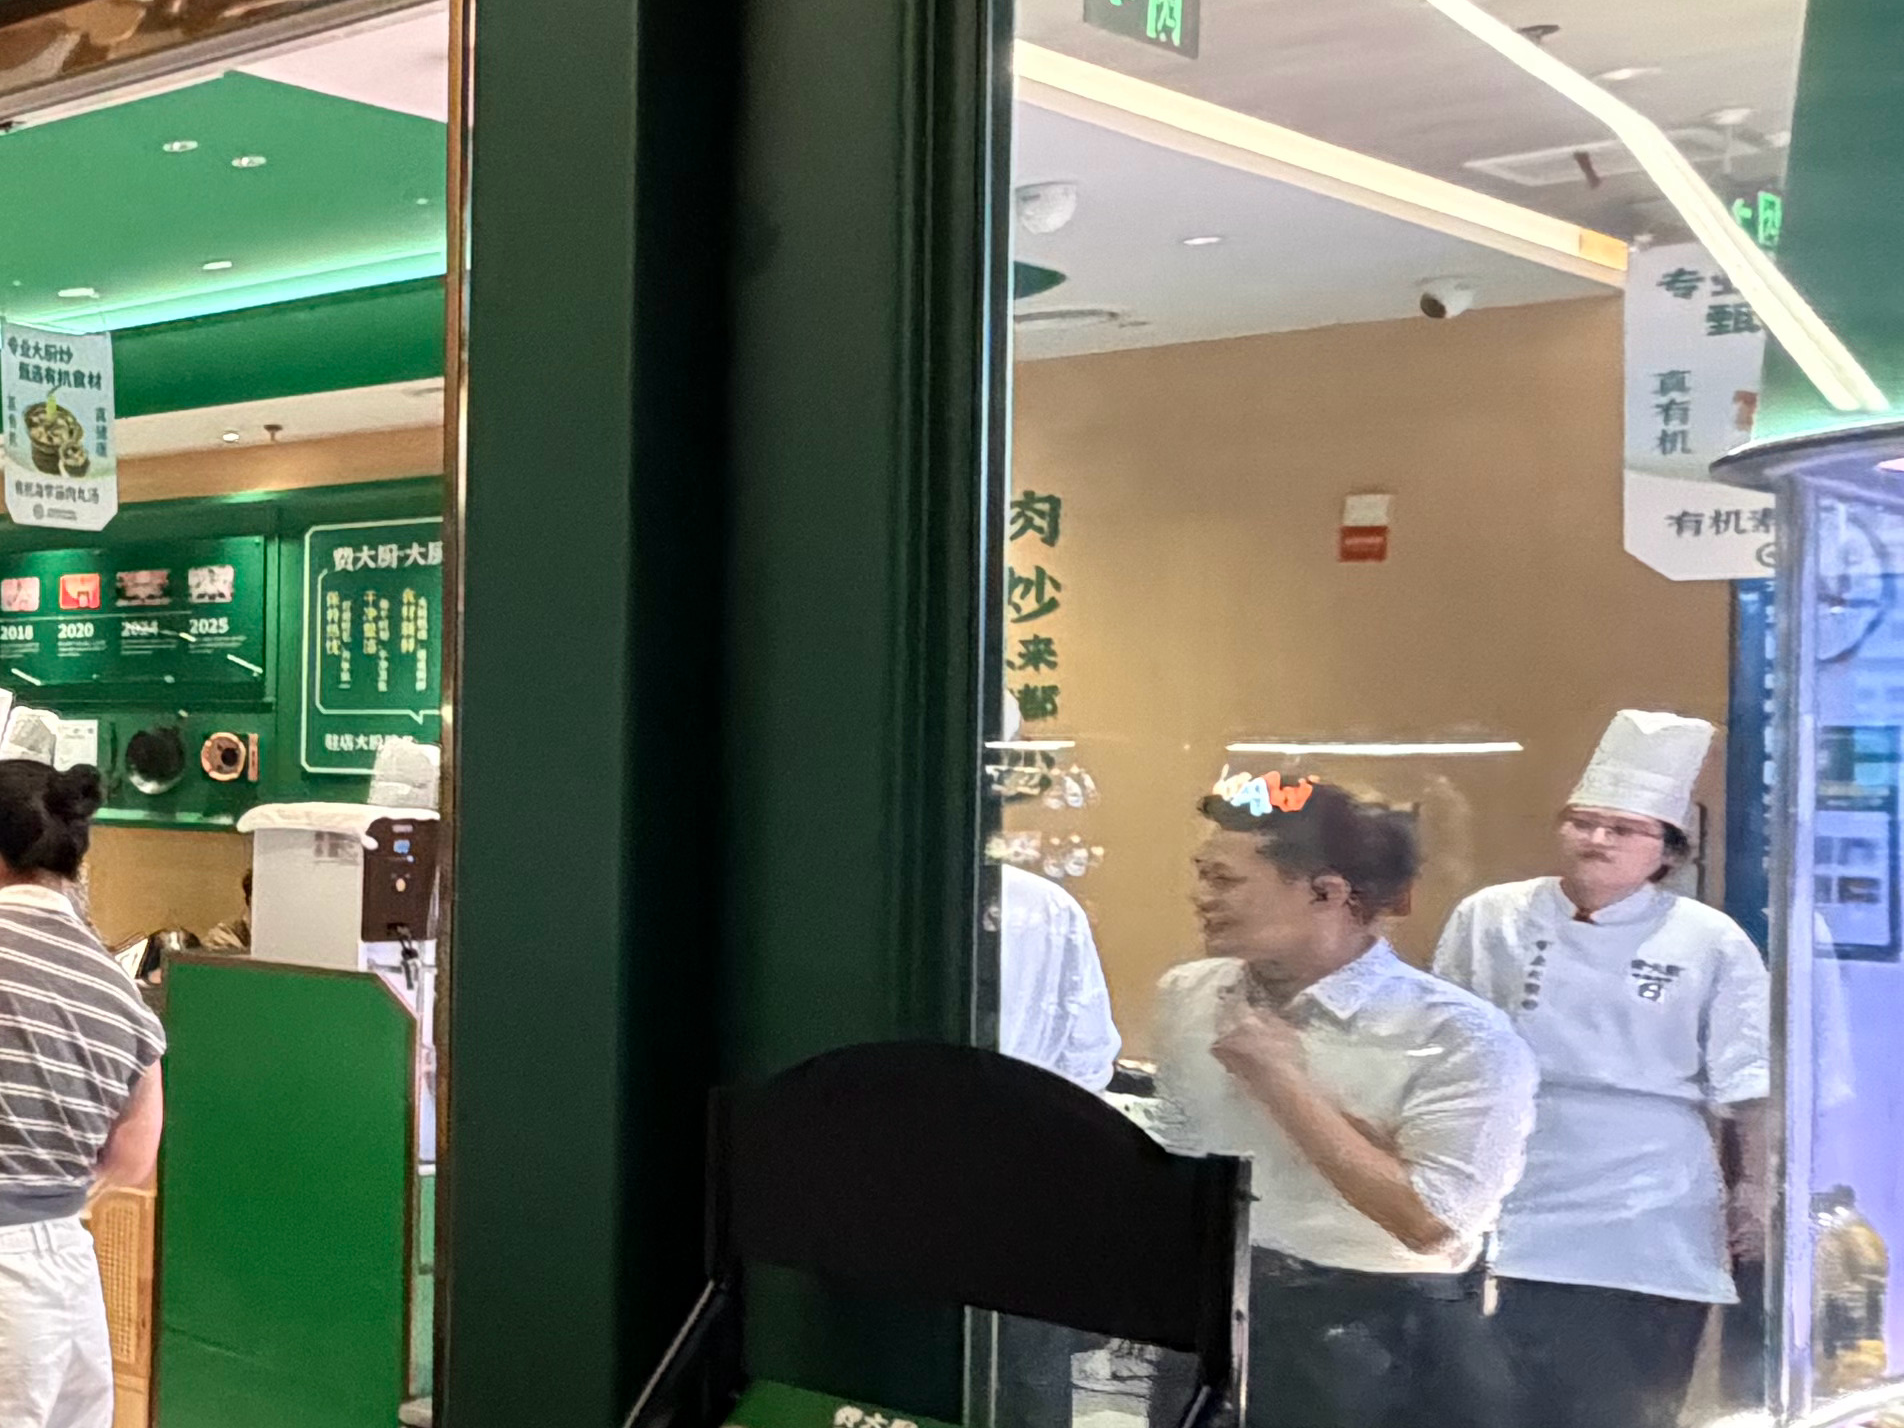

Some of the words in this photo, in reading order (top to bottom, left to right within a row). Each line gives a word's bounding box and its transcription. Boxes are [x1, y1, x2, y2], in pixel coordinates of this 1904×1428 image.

[1652, 370, 1692, 455] 真有机
[0, 624, 34, 641] 2018
[57, 622, 95, 639] 2020
[188, 616, 230, 635] 2025
